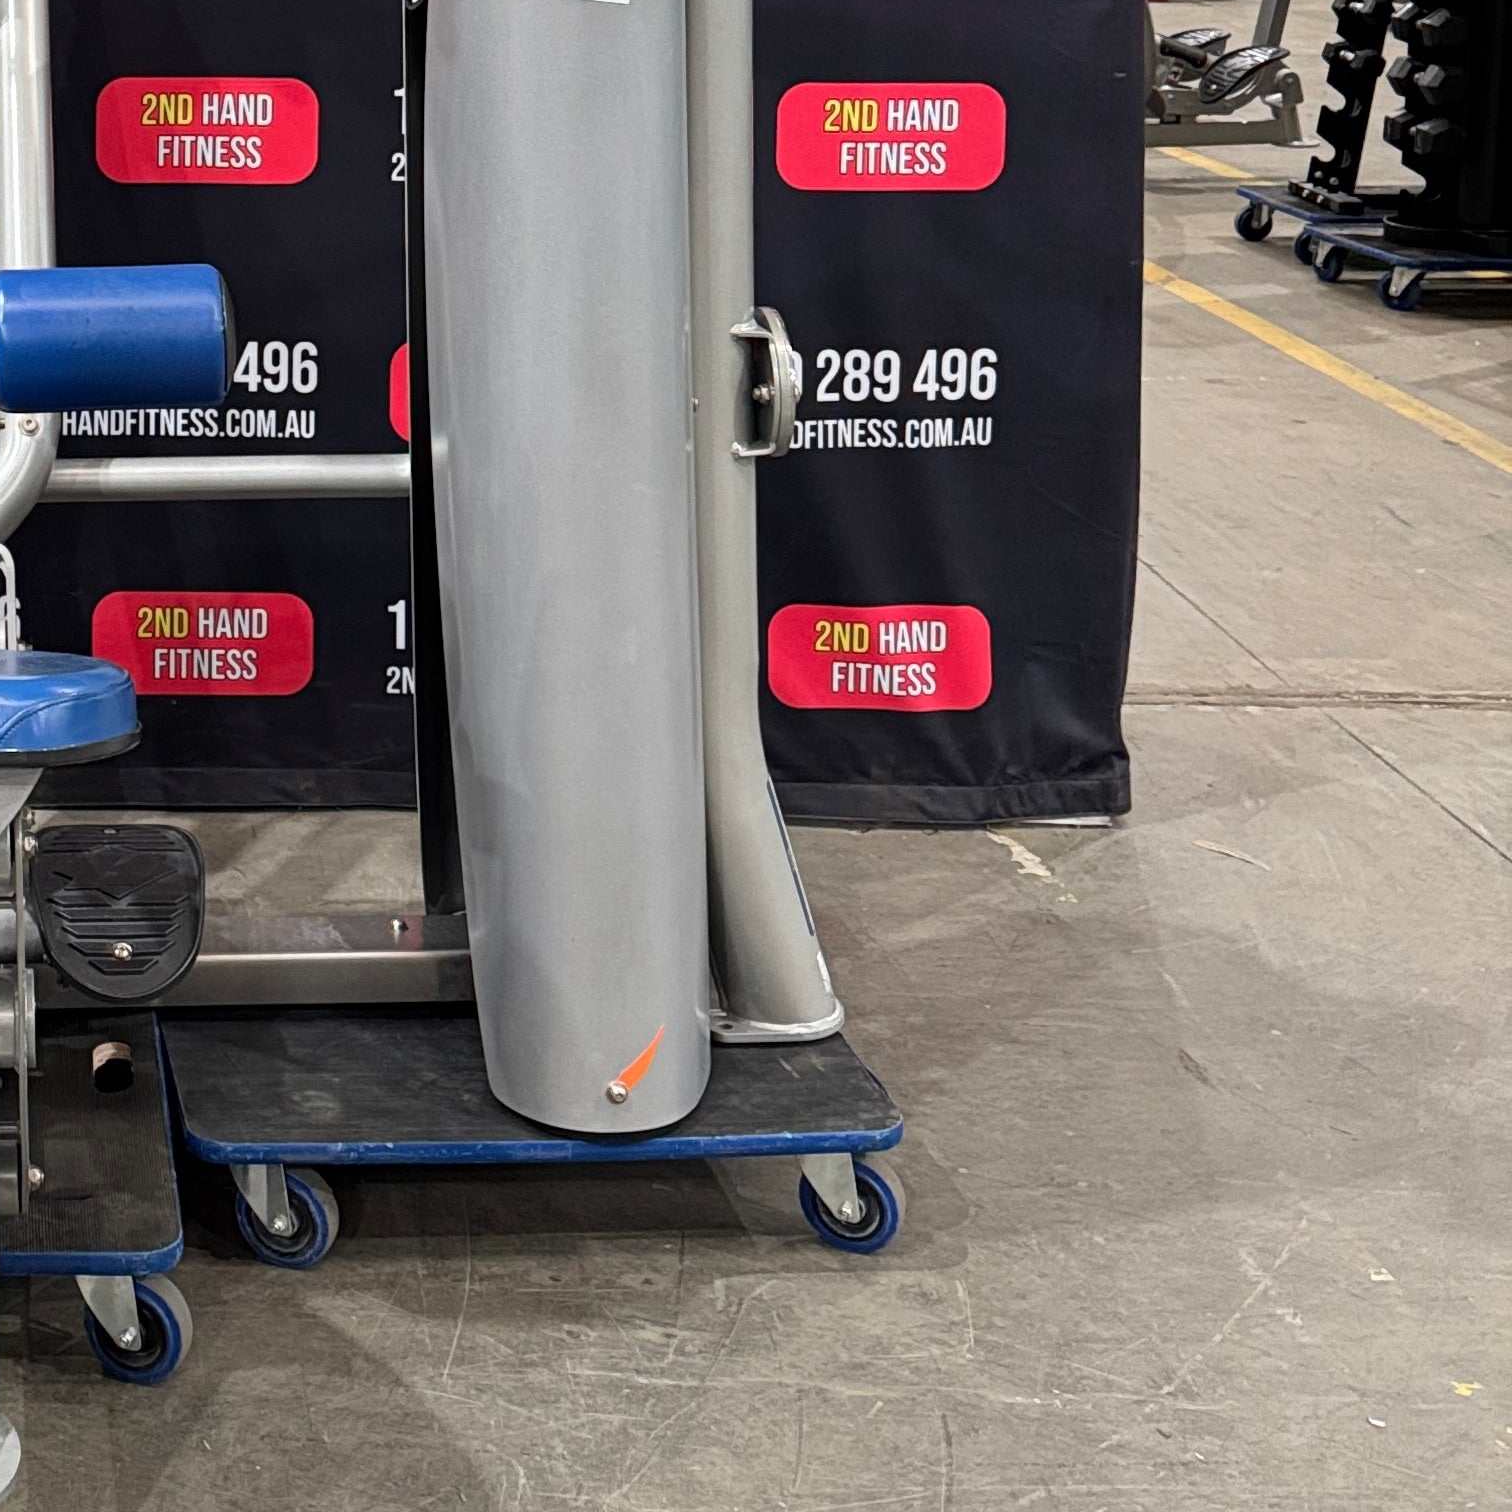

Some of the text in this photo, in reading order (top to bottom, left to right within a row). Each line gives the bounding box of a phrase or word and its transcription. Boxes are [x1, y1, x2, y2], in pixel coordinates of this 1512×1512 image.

[143, 94, 272, 125] 2ND HAND
[825, 100, 958, 131] 2ND HAND
[159, 136, 261, 168] FITNESS
[841, 142, 946, 174] FITNESS
[234, 341, 317, 393] 496
[817, 349, 900, 402] 289
[913, 348, 997, 400] 496
[139, 608, 267, 638] 2ND HAND
[816, 621, 946, 654] 2ND HAND
[155, 649, 256, 679] FITNESS
[833, 662, 936, 695] FITNESS
